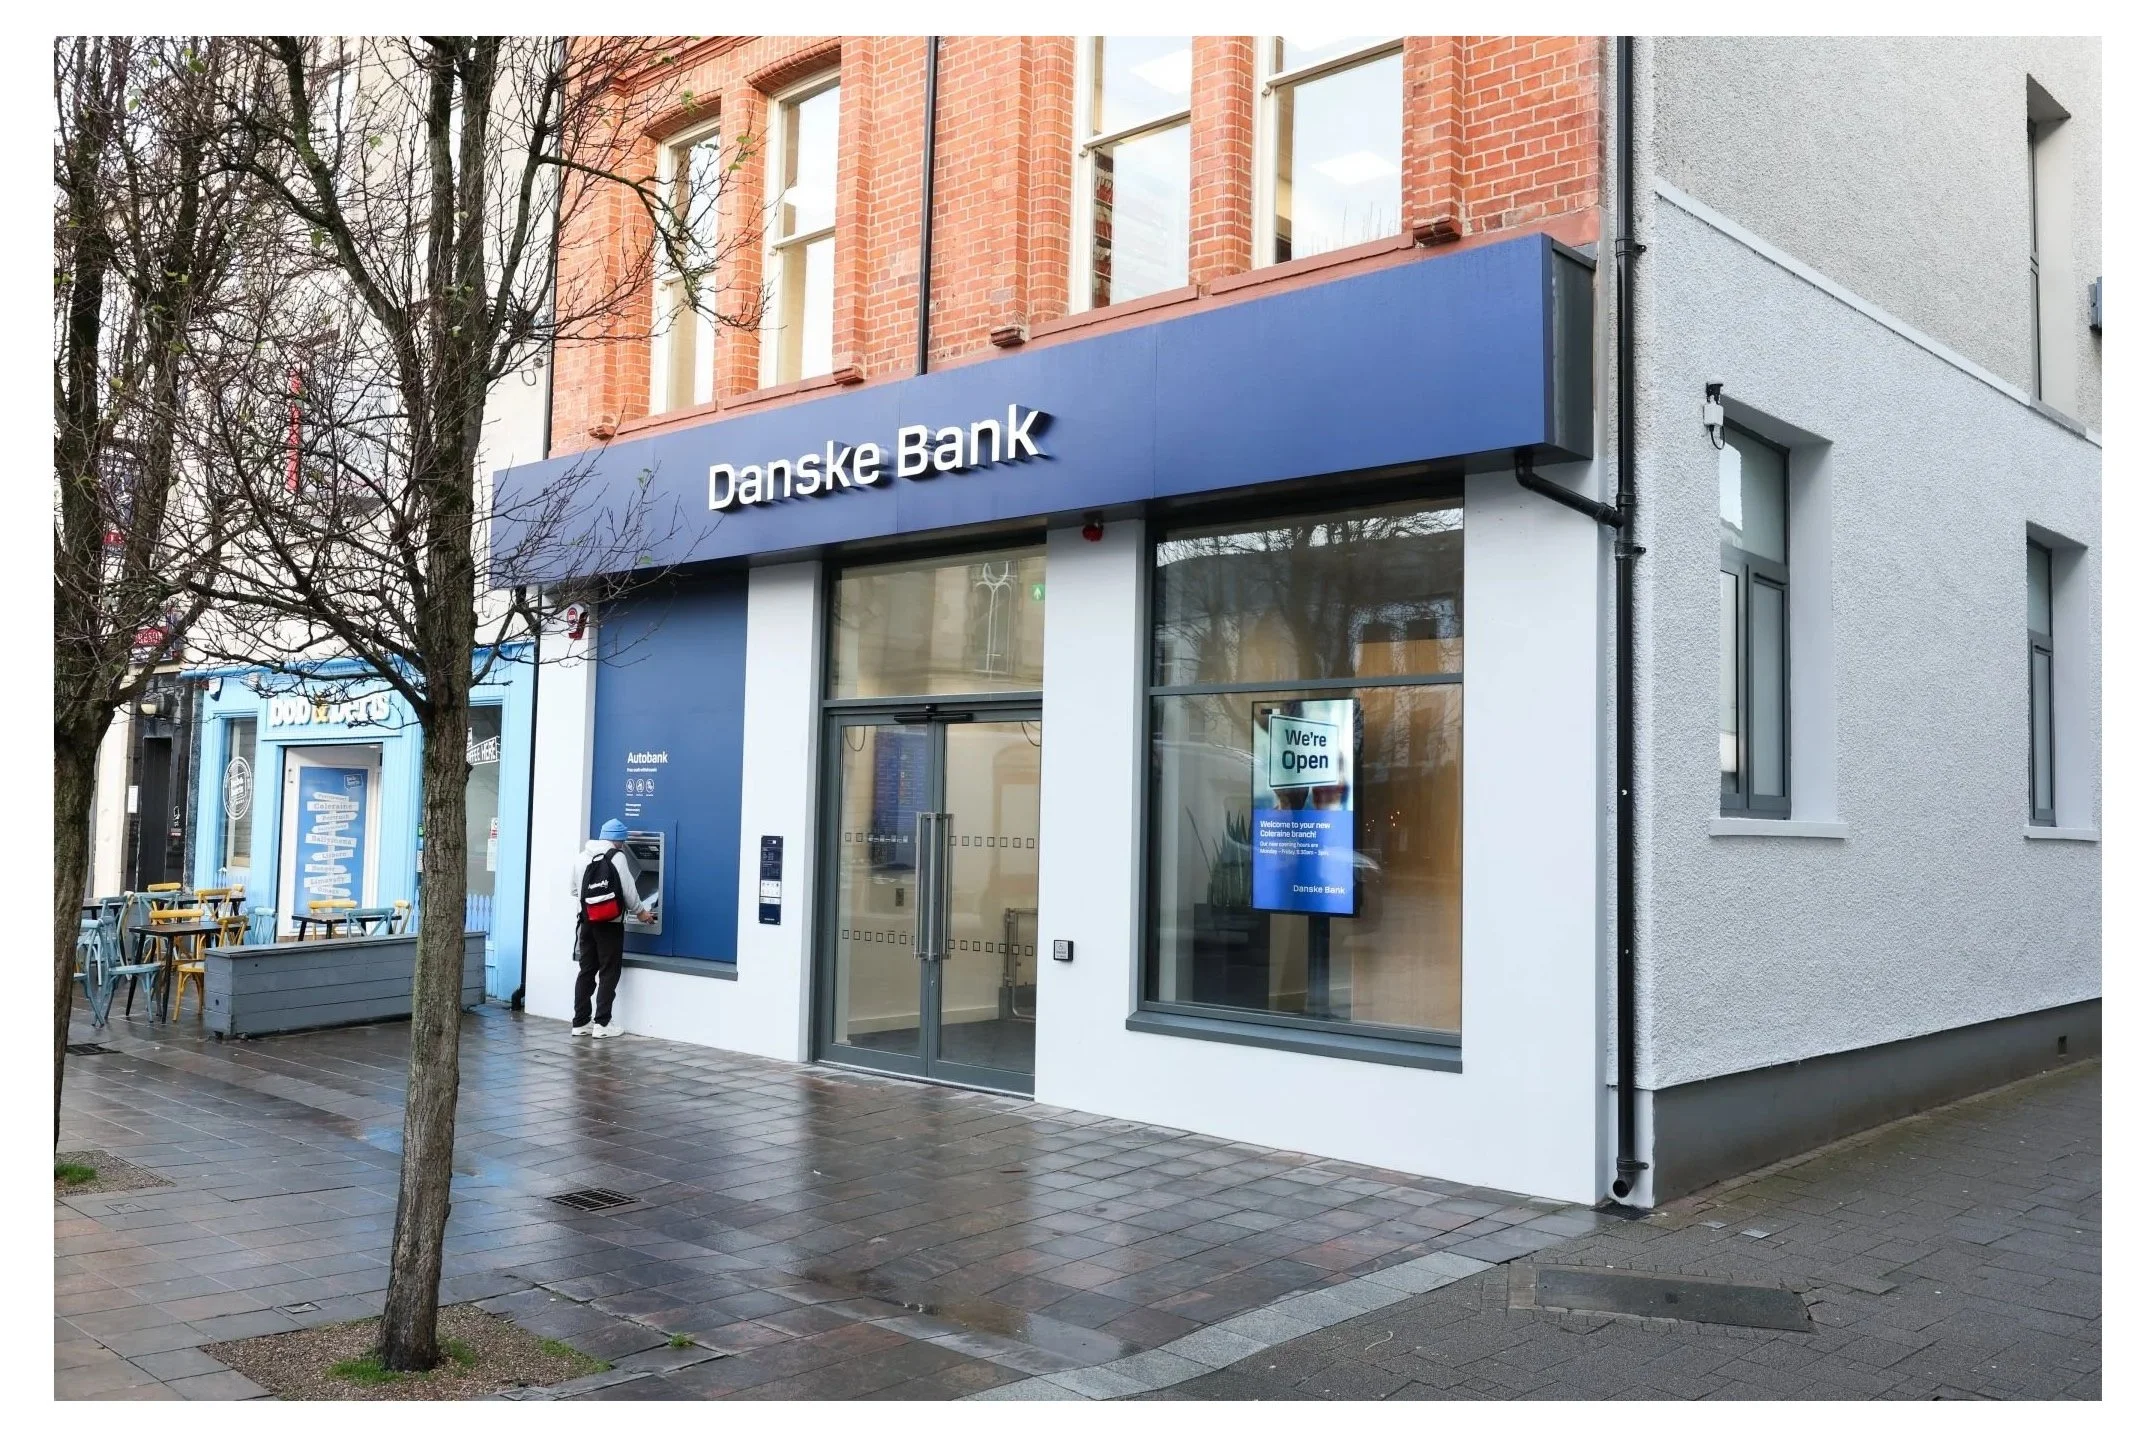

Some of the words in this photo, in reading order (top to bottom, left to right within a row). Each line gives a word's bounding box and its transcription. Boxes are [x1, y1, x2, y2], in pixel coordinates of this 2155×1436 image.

[707, 439, 883, 511] Danske
[896, 403, 1042, 478] Bank
[1285, 729, 1327, 747] We're
[481, 739, 497, 761] HERE
[627, 751, 668, 764] Autobank
[1281, 750, 1329, 774] Open
[313, 802, 353, 810] Coleraine
[1260, 820, 1291, 829] Welcome
[1299, 822, 1314, 830] your
[1260, 829, 1290, 838] Coleraine
[1291, 830, 1317, 838] branch!
[1293, 884, 1323, 893] Danske
[1324, 885, 1346, 895] Bank
